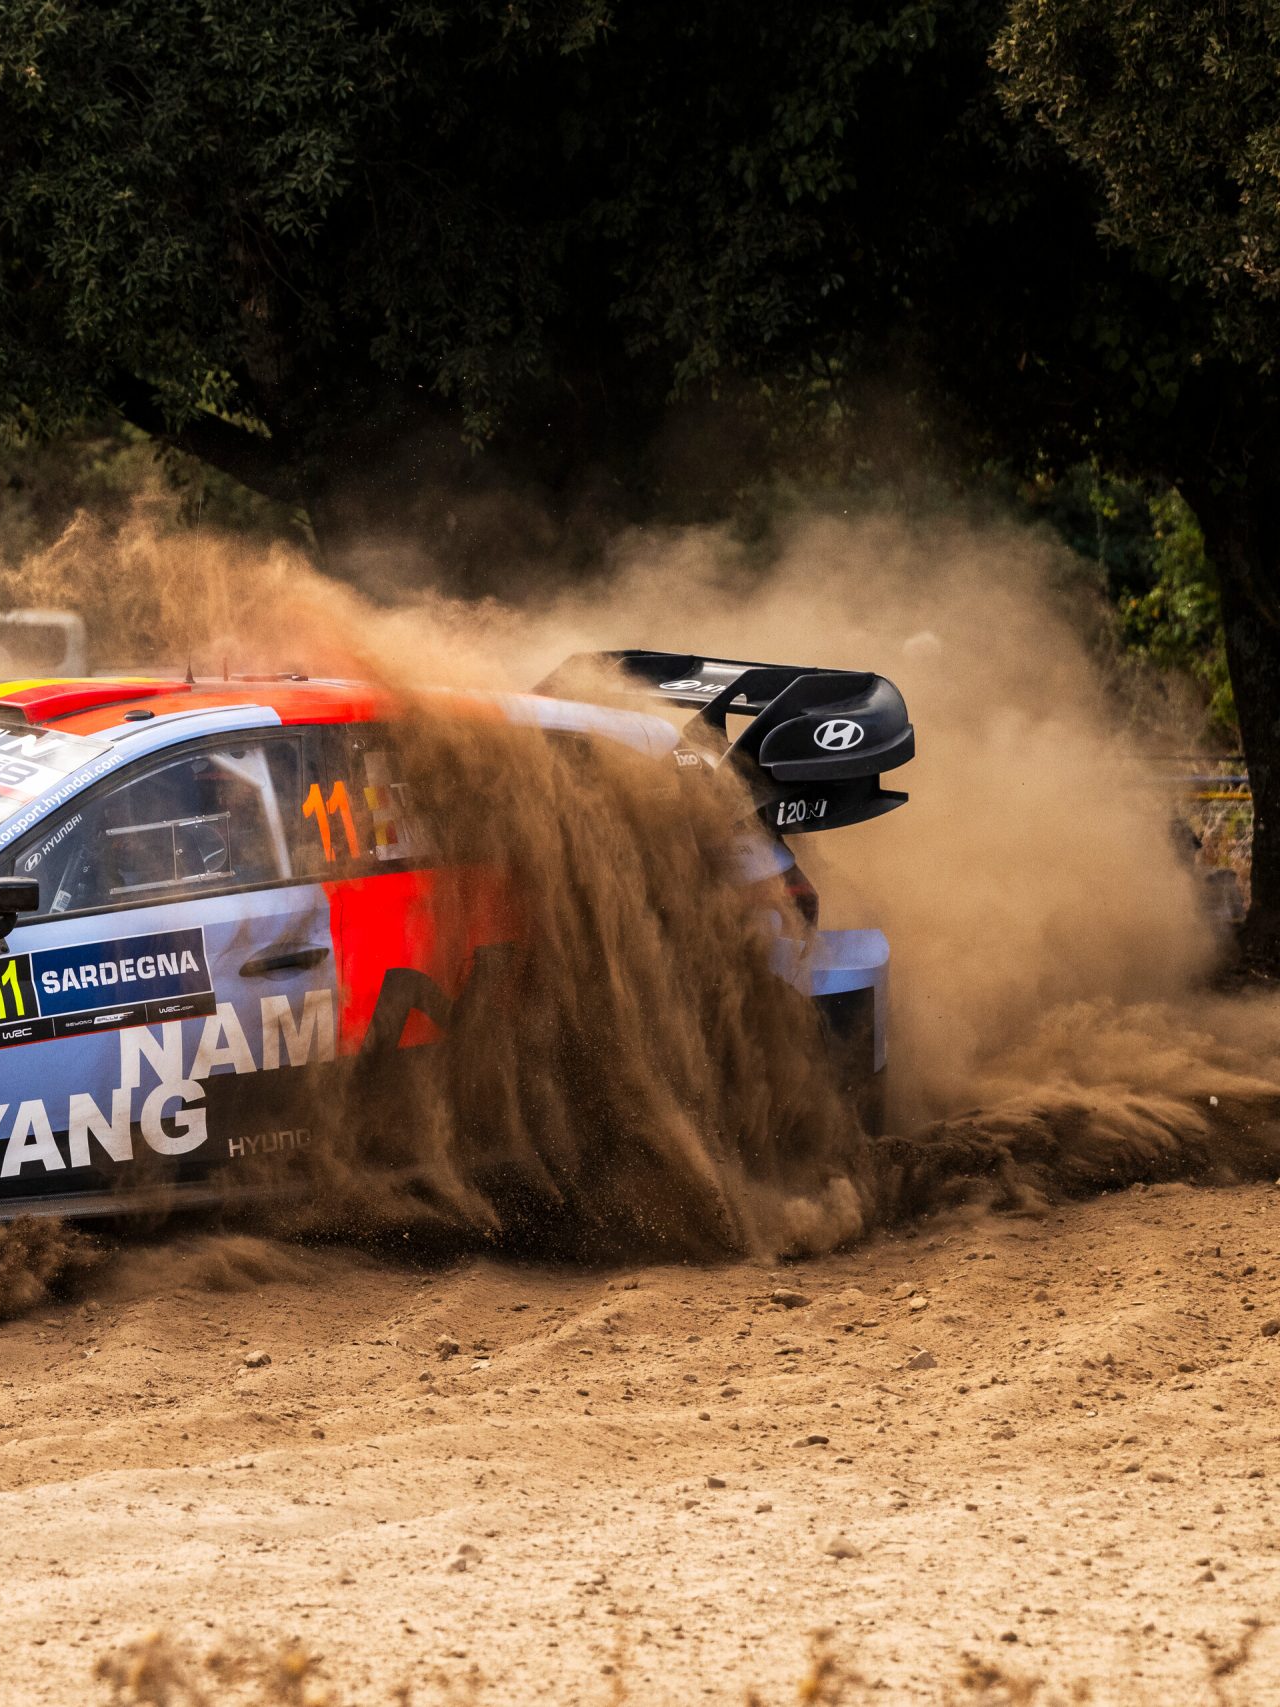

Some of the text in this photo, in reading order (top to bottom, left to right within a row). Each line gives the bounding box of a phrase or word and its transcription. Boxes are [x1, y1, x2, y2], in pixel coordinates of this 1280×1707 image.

[42, 813, 83, 855] HYUNDAI
[302, 780, 360, 863] 11
[41, 949, 200, 995] SARDEGNA
[2, 1027, 33, 1040] WRC
[120, 988, 336, 1090] NAM
[228, 1128, 313, 1158] HYUND
